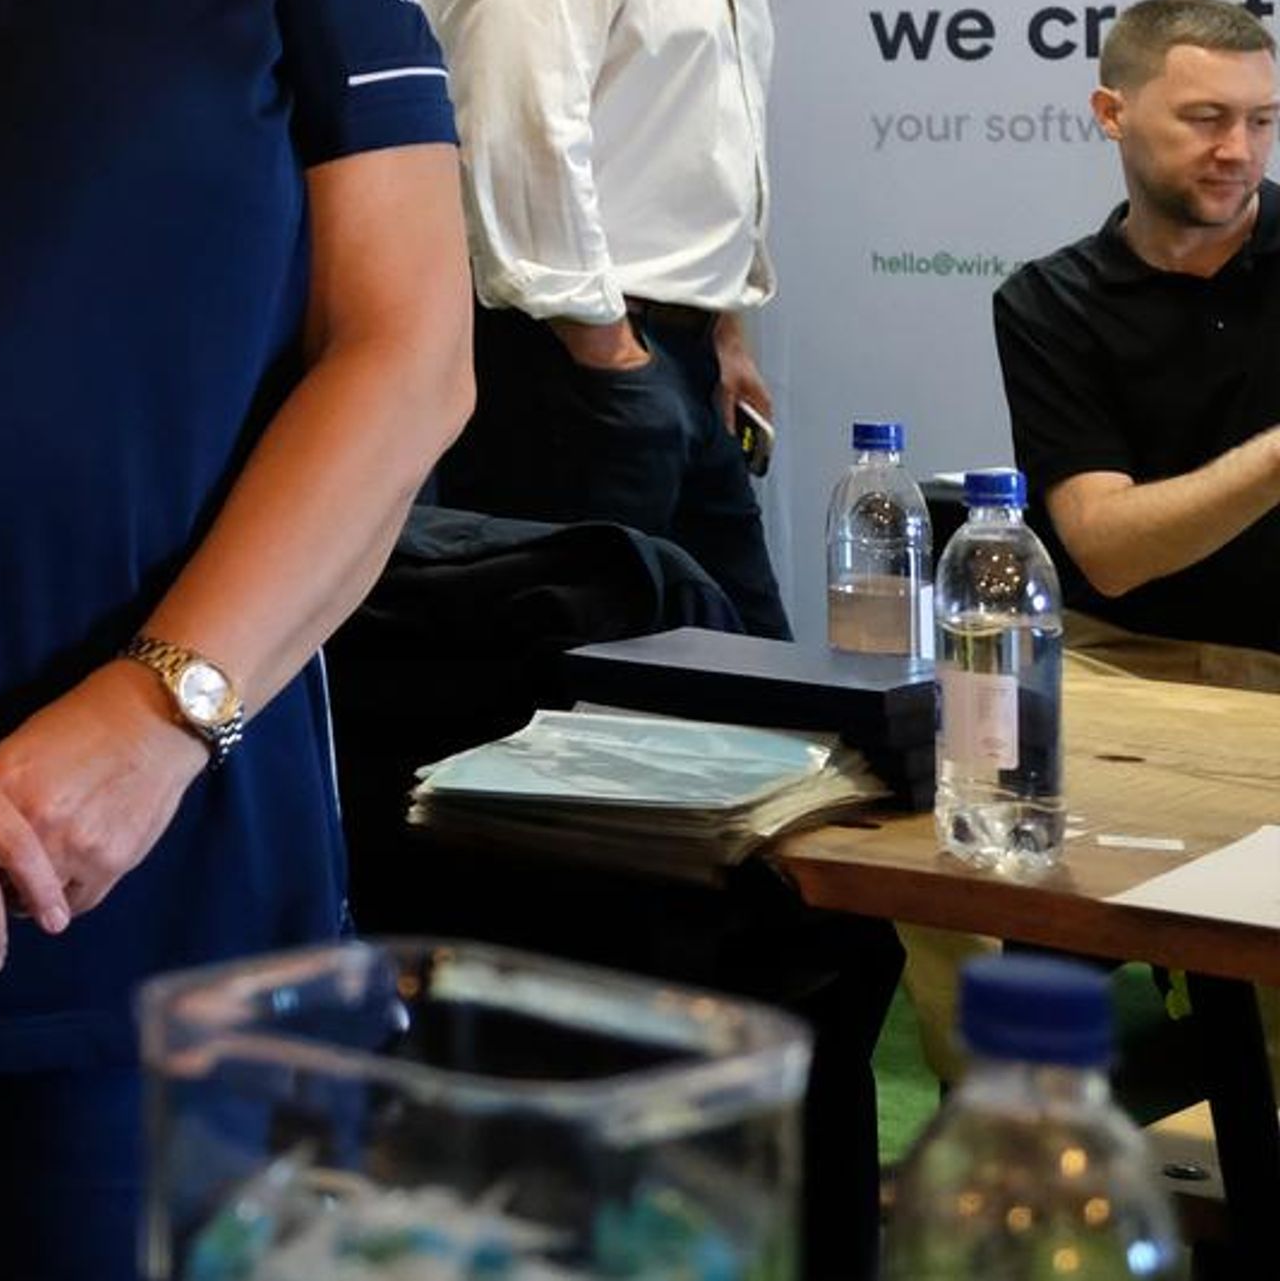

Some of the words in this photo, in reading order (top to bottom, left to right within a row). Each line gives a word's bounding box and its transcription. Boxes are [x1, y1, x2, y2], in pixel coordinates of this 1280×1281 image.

[869, 8, 995, 61] we
[870, 113, 971, 150] your
[985, 104, 1107, 143] softw
